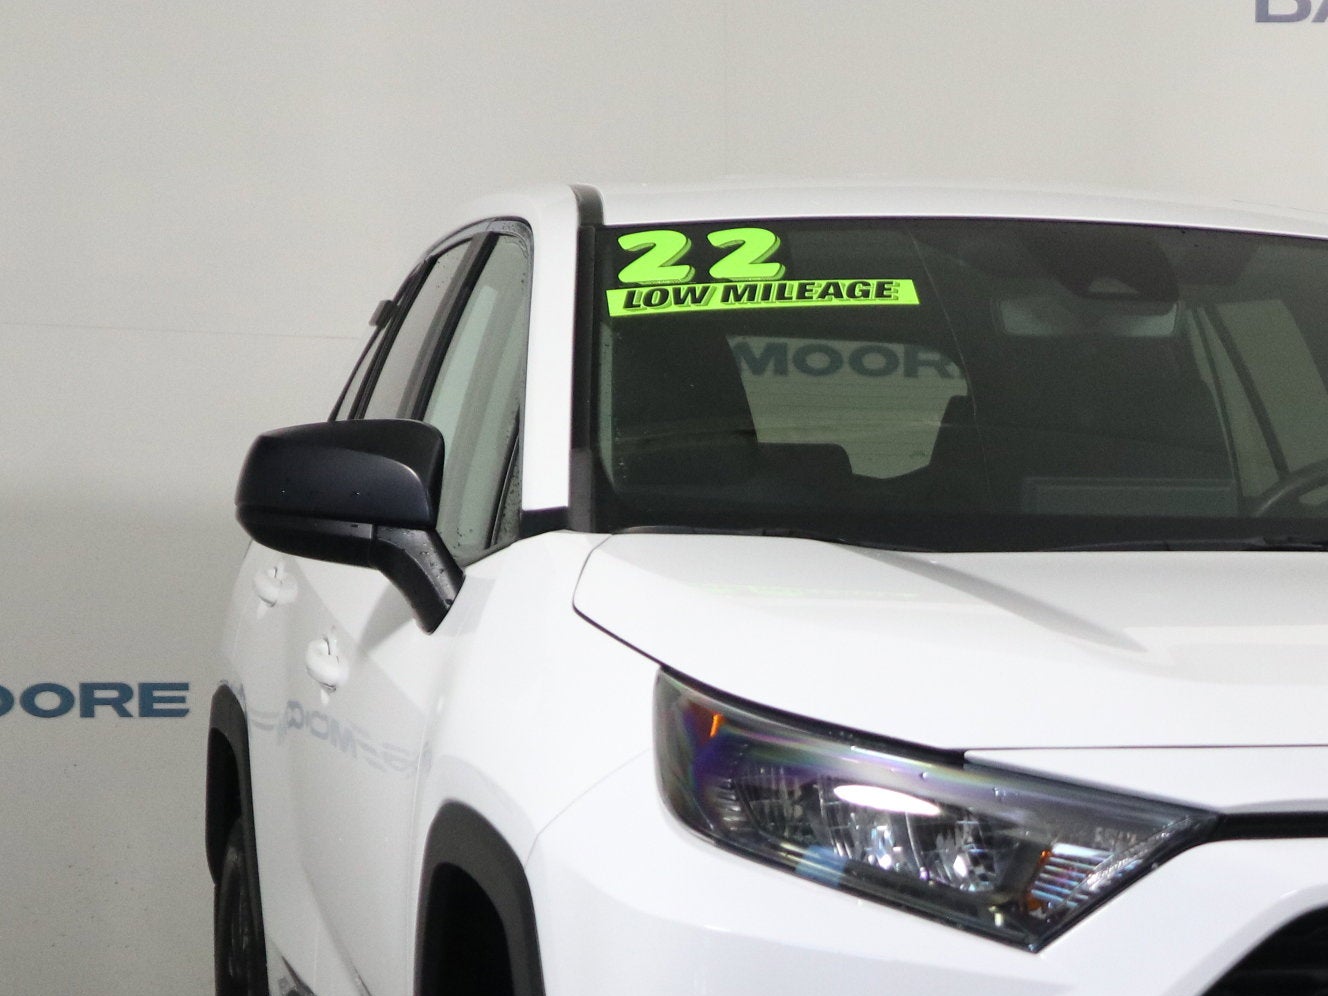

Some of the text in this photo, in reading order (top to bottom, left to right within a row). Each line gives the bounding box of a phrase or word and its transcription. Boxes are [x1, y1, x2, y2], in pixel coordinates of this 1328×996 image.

[617, 227, 786, 284] 22
[622, 280, 900, 310] LOW MILEAGE
[0, 682, 190, 718] ORE
